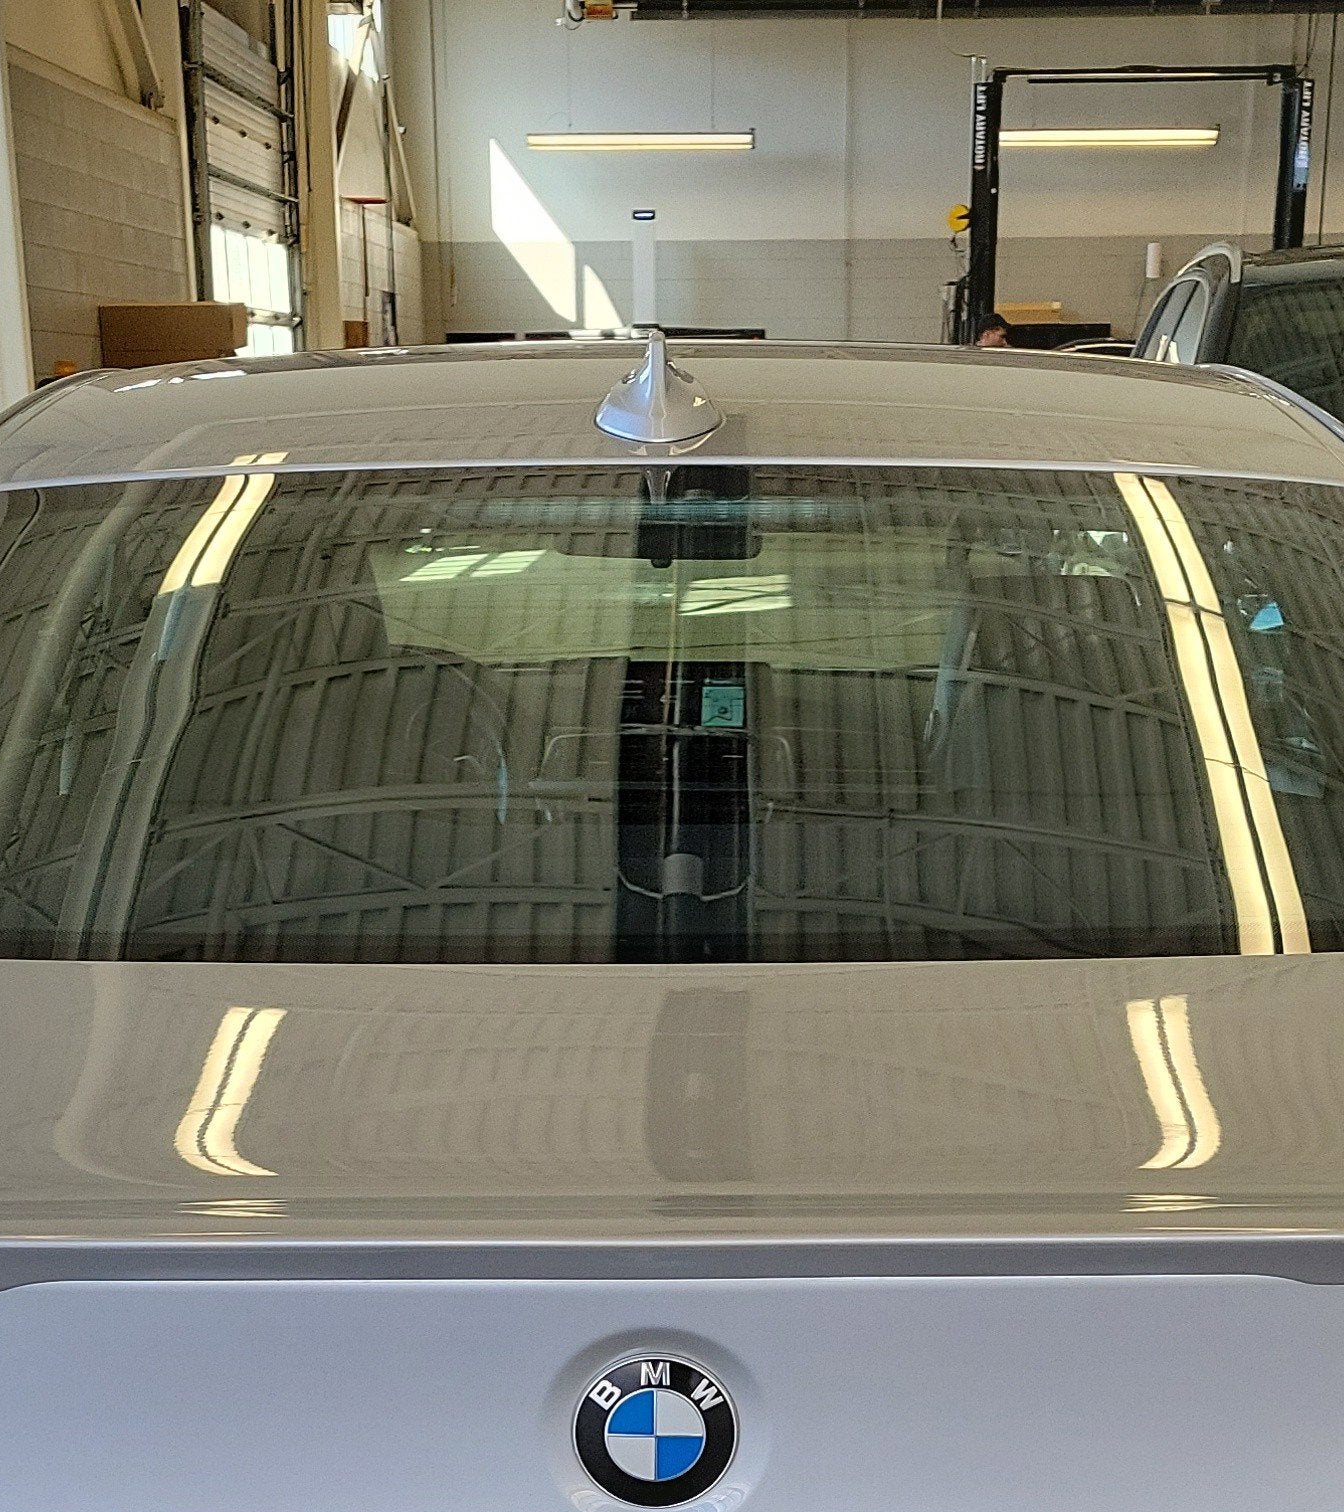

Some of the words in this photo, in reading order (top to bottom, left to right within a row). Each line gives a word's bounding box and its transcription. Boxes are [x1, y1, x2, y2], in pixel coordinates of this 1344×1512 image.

[977, 86, 987, 111] LIFT
[1302, 82, 1312, 107] LIFT
[975, 114, 986, 163] ROTARY
[588, 1361, 725, 1411] BMW
